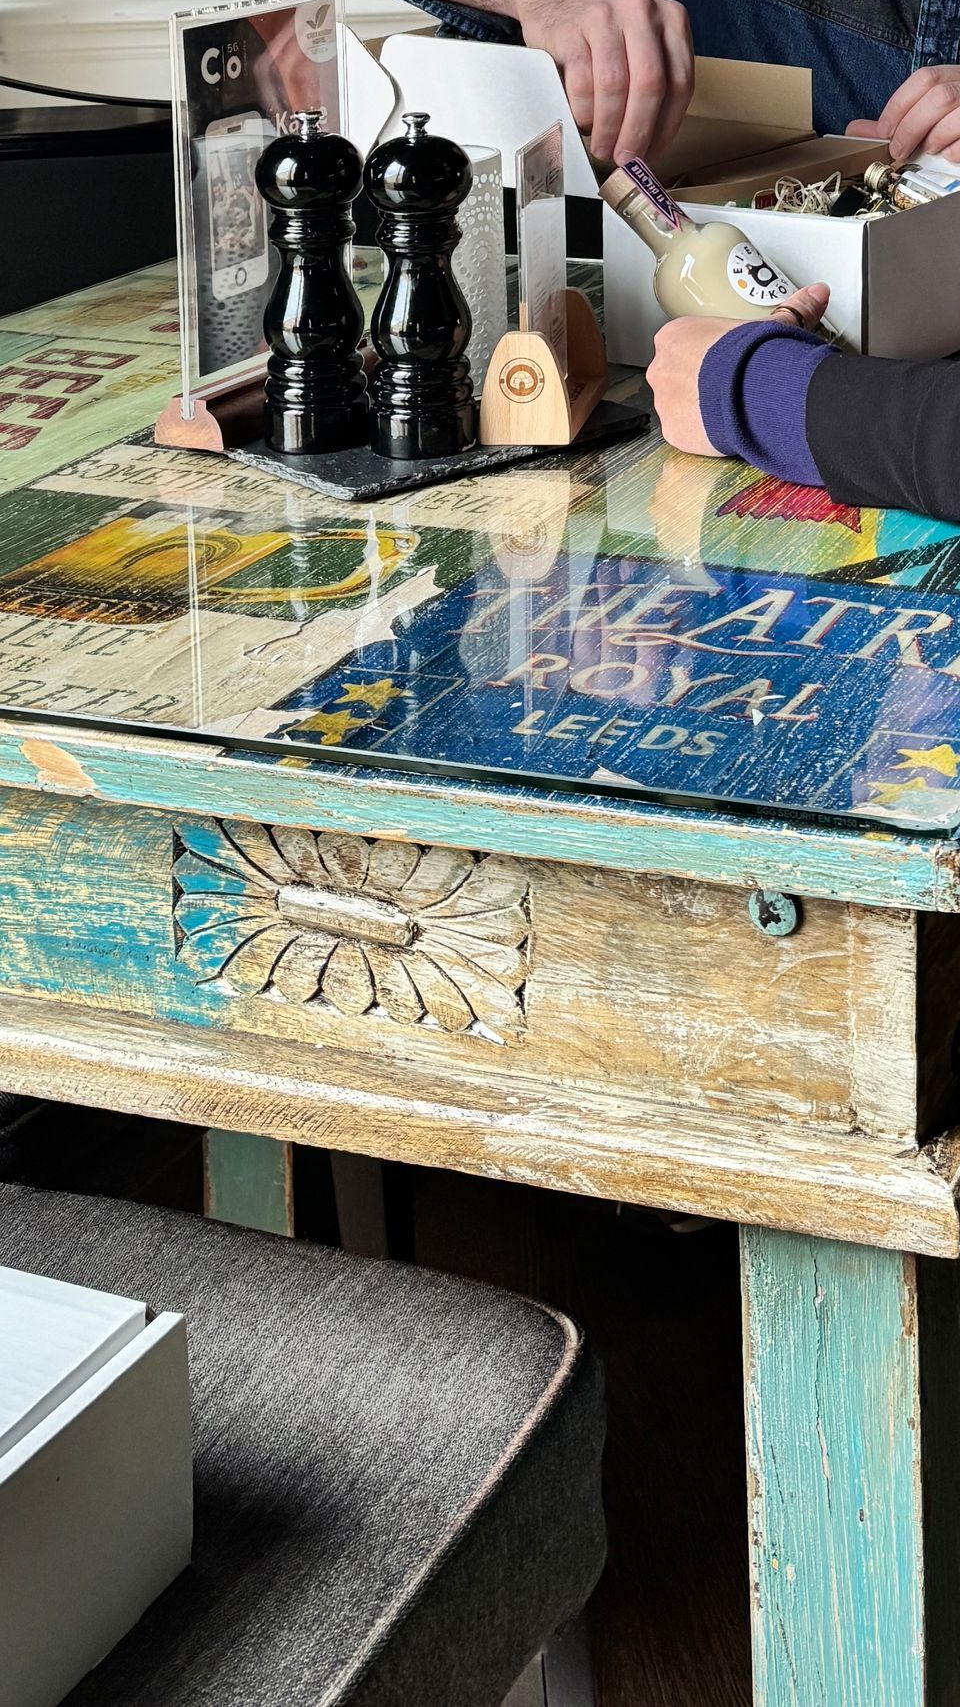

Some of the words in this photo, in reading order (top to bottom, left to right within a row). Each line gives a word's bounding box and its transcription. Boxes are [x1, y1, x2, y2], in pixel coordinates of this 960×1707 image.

[275, 105, 328, 135] Kae
[487, 652, 823, 722] ROYAL
[511, 709, 728, 756] LEEDS
[778, 808, 816, 822] SECURIT
[818, 814, 832, 823] EN
